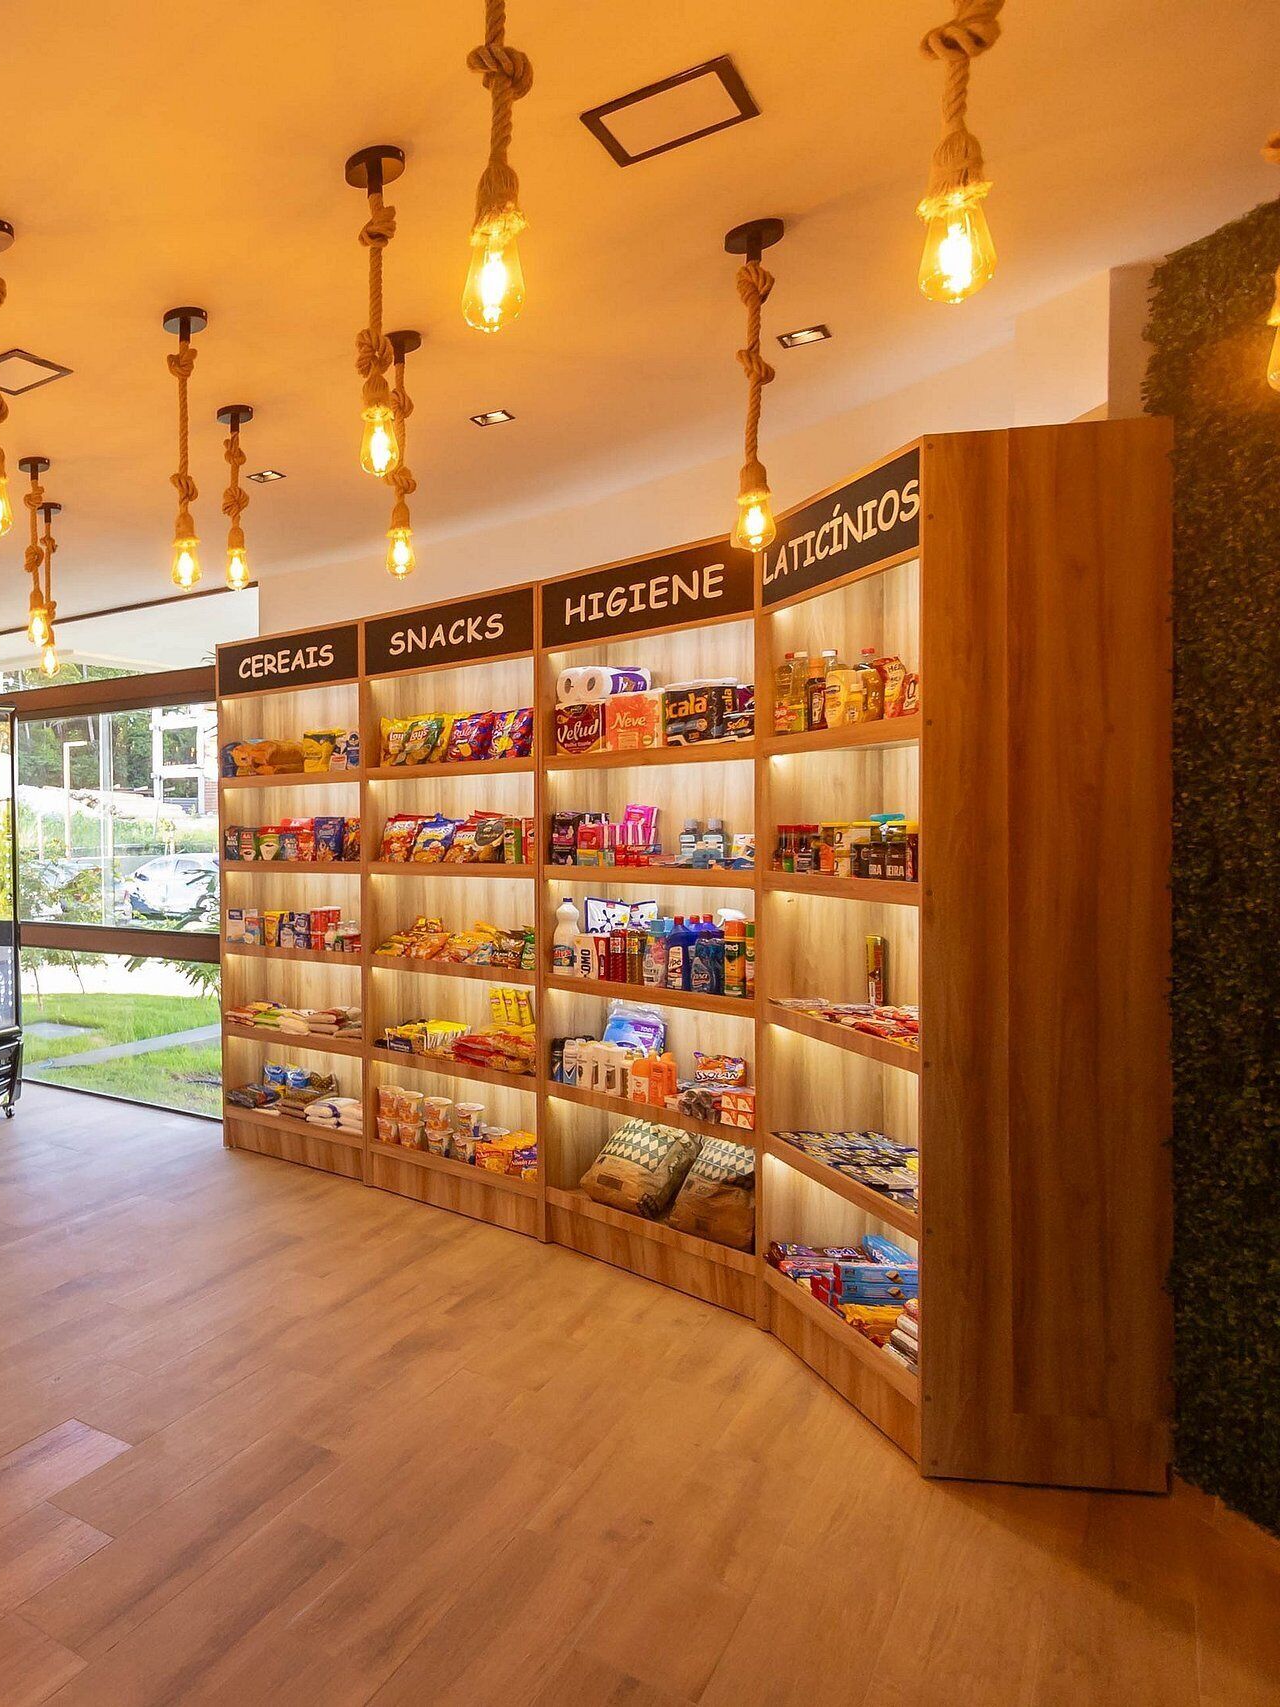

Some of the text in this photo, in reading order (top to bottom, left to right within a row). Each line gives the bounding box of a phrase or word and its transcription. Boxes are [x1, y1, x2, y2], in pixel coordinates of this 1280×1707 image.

[763, 479, 920, 585] LATICÍNIOS
[565, 563, 725, 626] HIGIENE
[389, 613, 504, 655] SNACKS
[238, 644, 334, 679] CEREAIS
[610, 711, 646, 730] Neve
